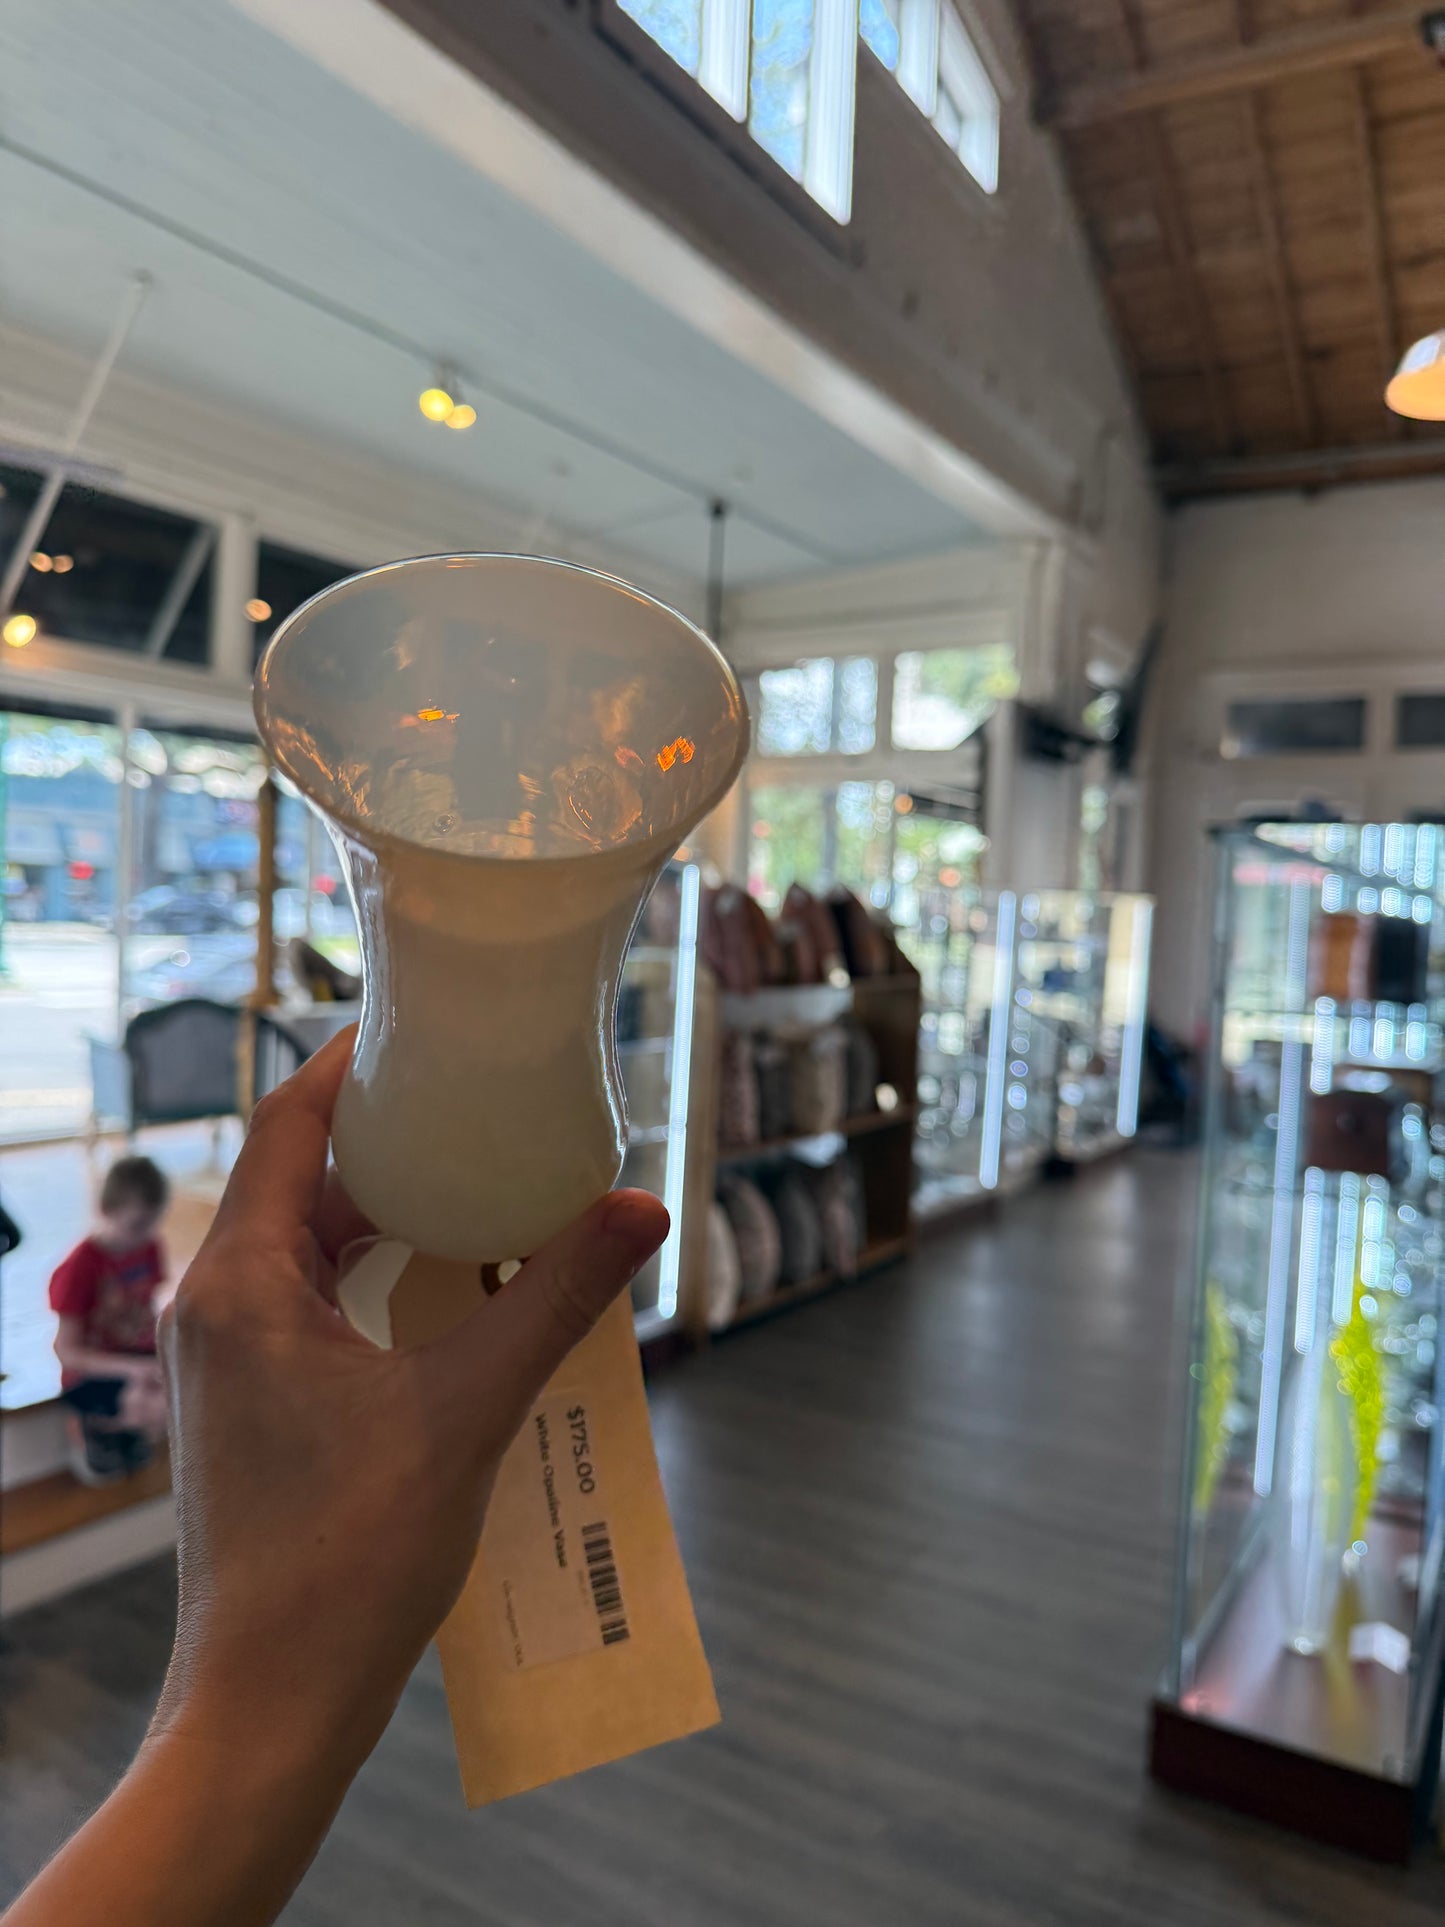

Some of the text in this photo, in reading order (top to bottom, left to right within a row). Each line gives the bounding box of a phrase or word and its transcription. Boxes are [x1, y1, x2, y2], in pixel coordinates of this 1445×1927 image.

[536, 1412, 567, 1568] White Opaline Vase
[567, 1405, 595, 1493] $175.00
